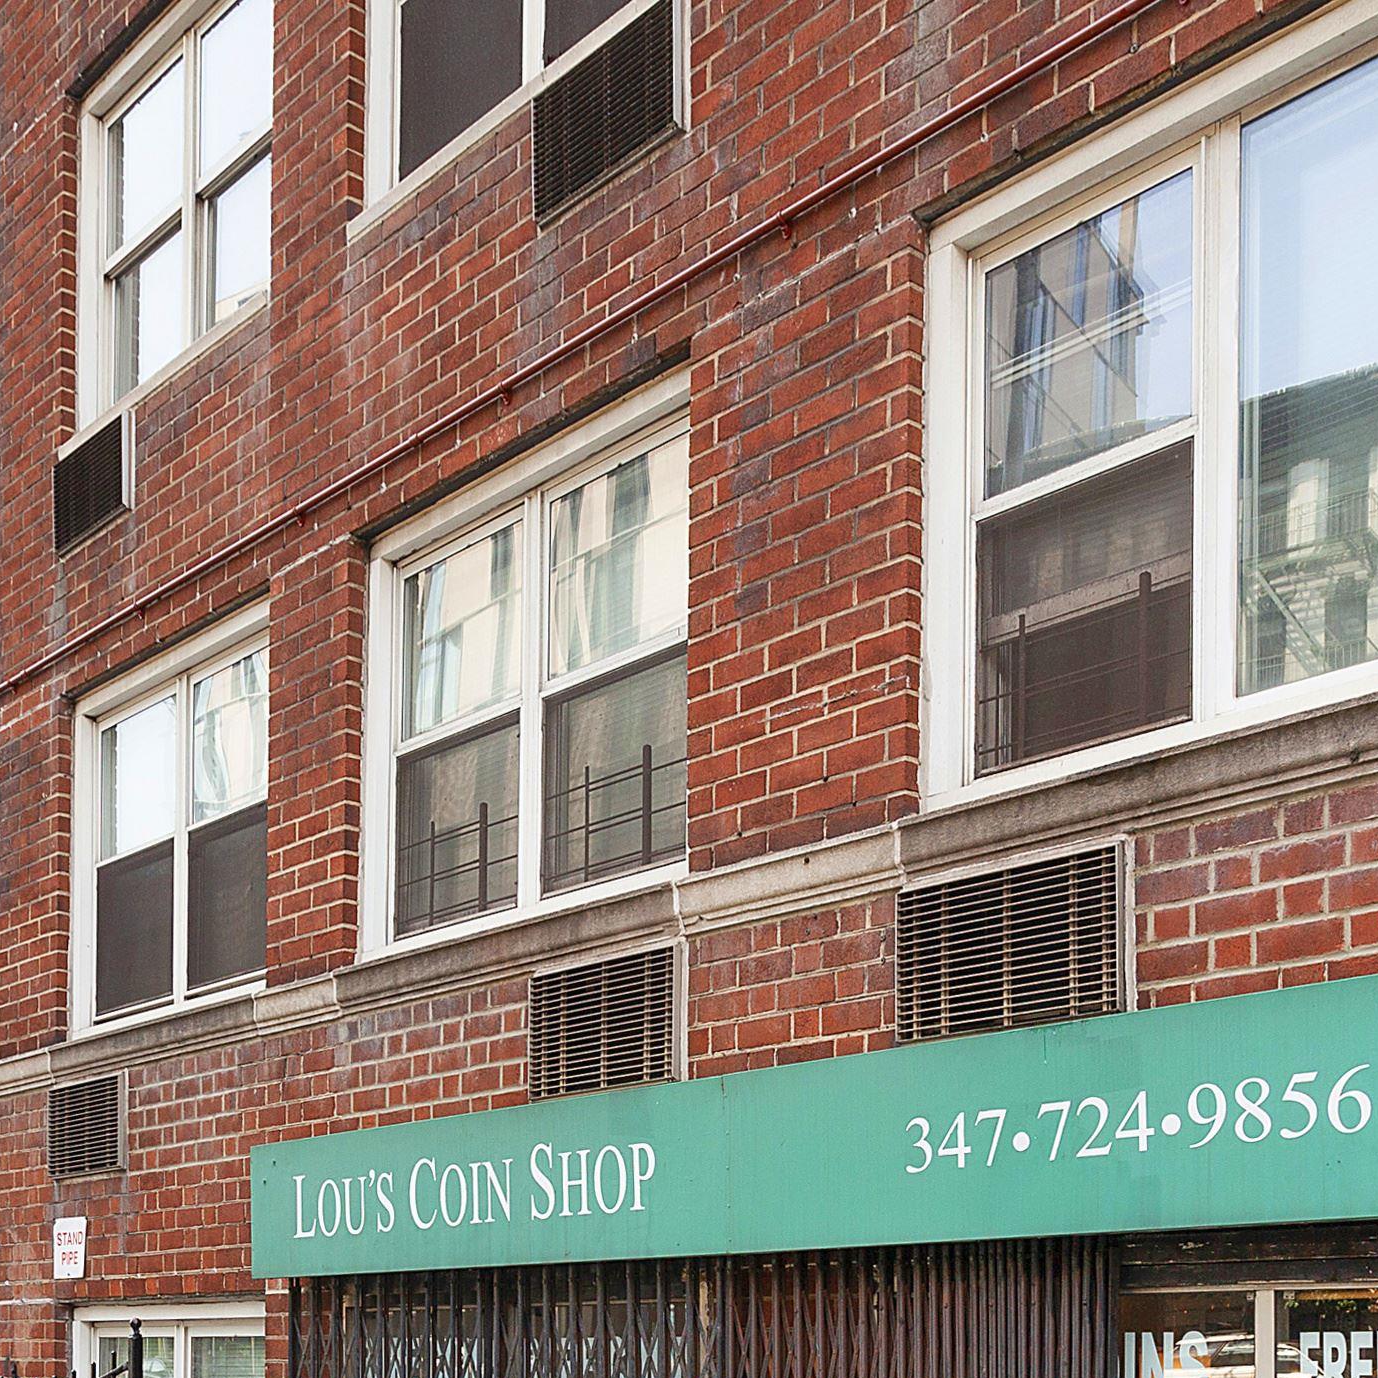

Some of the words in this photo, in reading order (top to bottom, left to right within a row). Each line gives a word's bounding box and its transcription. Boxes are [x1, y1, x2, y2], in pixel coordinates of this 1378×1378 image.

[408, 1157, 514, 1231] COIN
[529, 1142, 657, 1221] SHOP
[56, 1231, 83, 1246] STAND
[61, 1251, 78, 1265] PIPE
